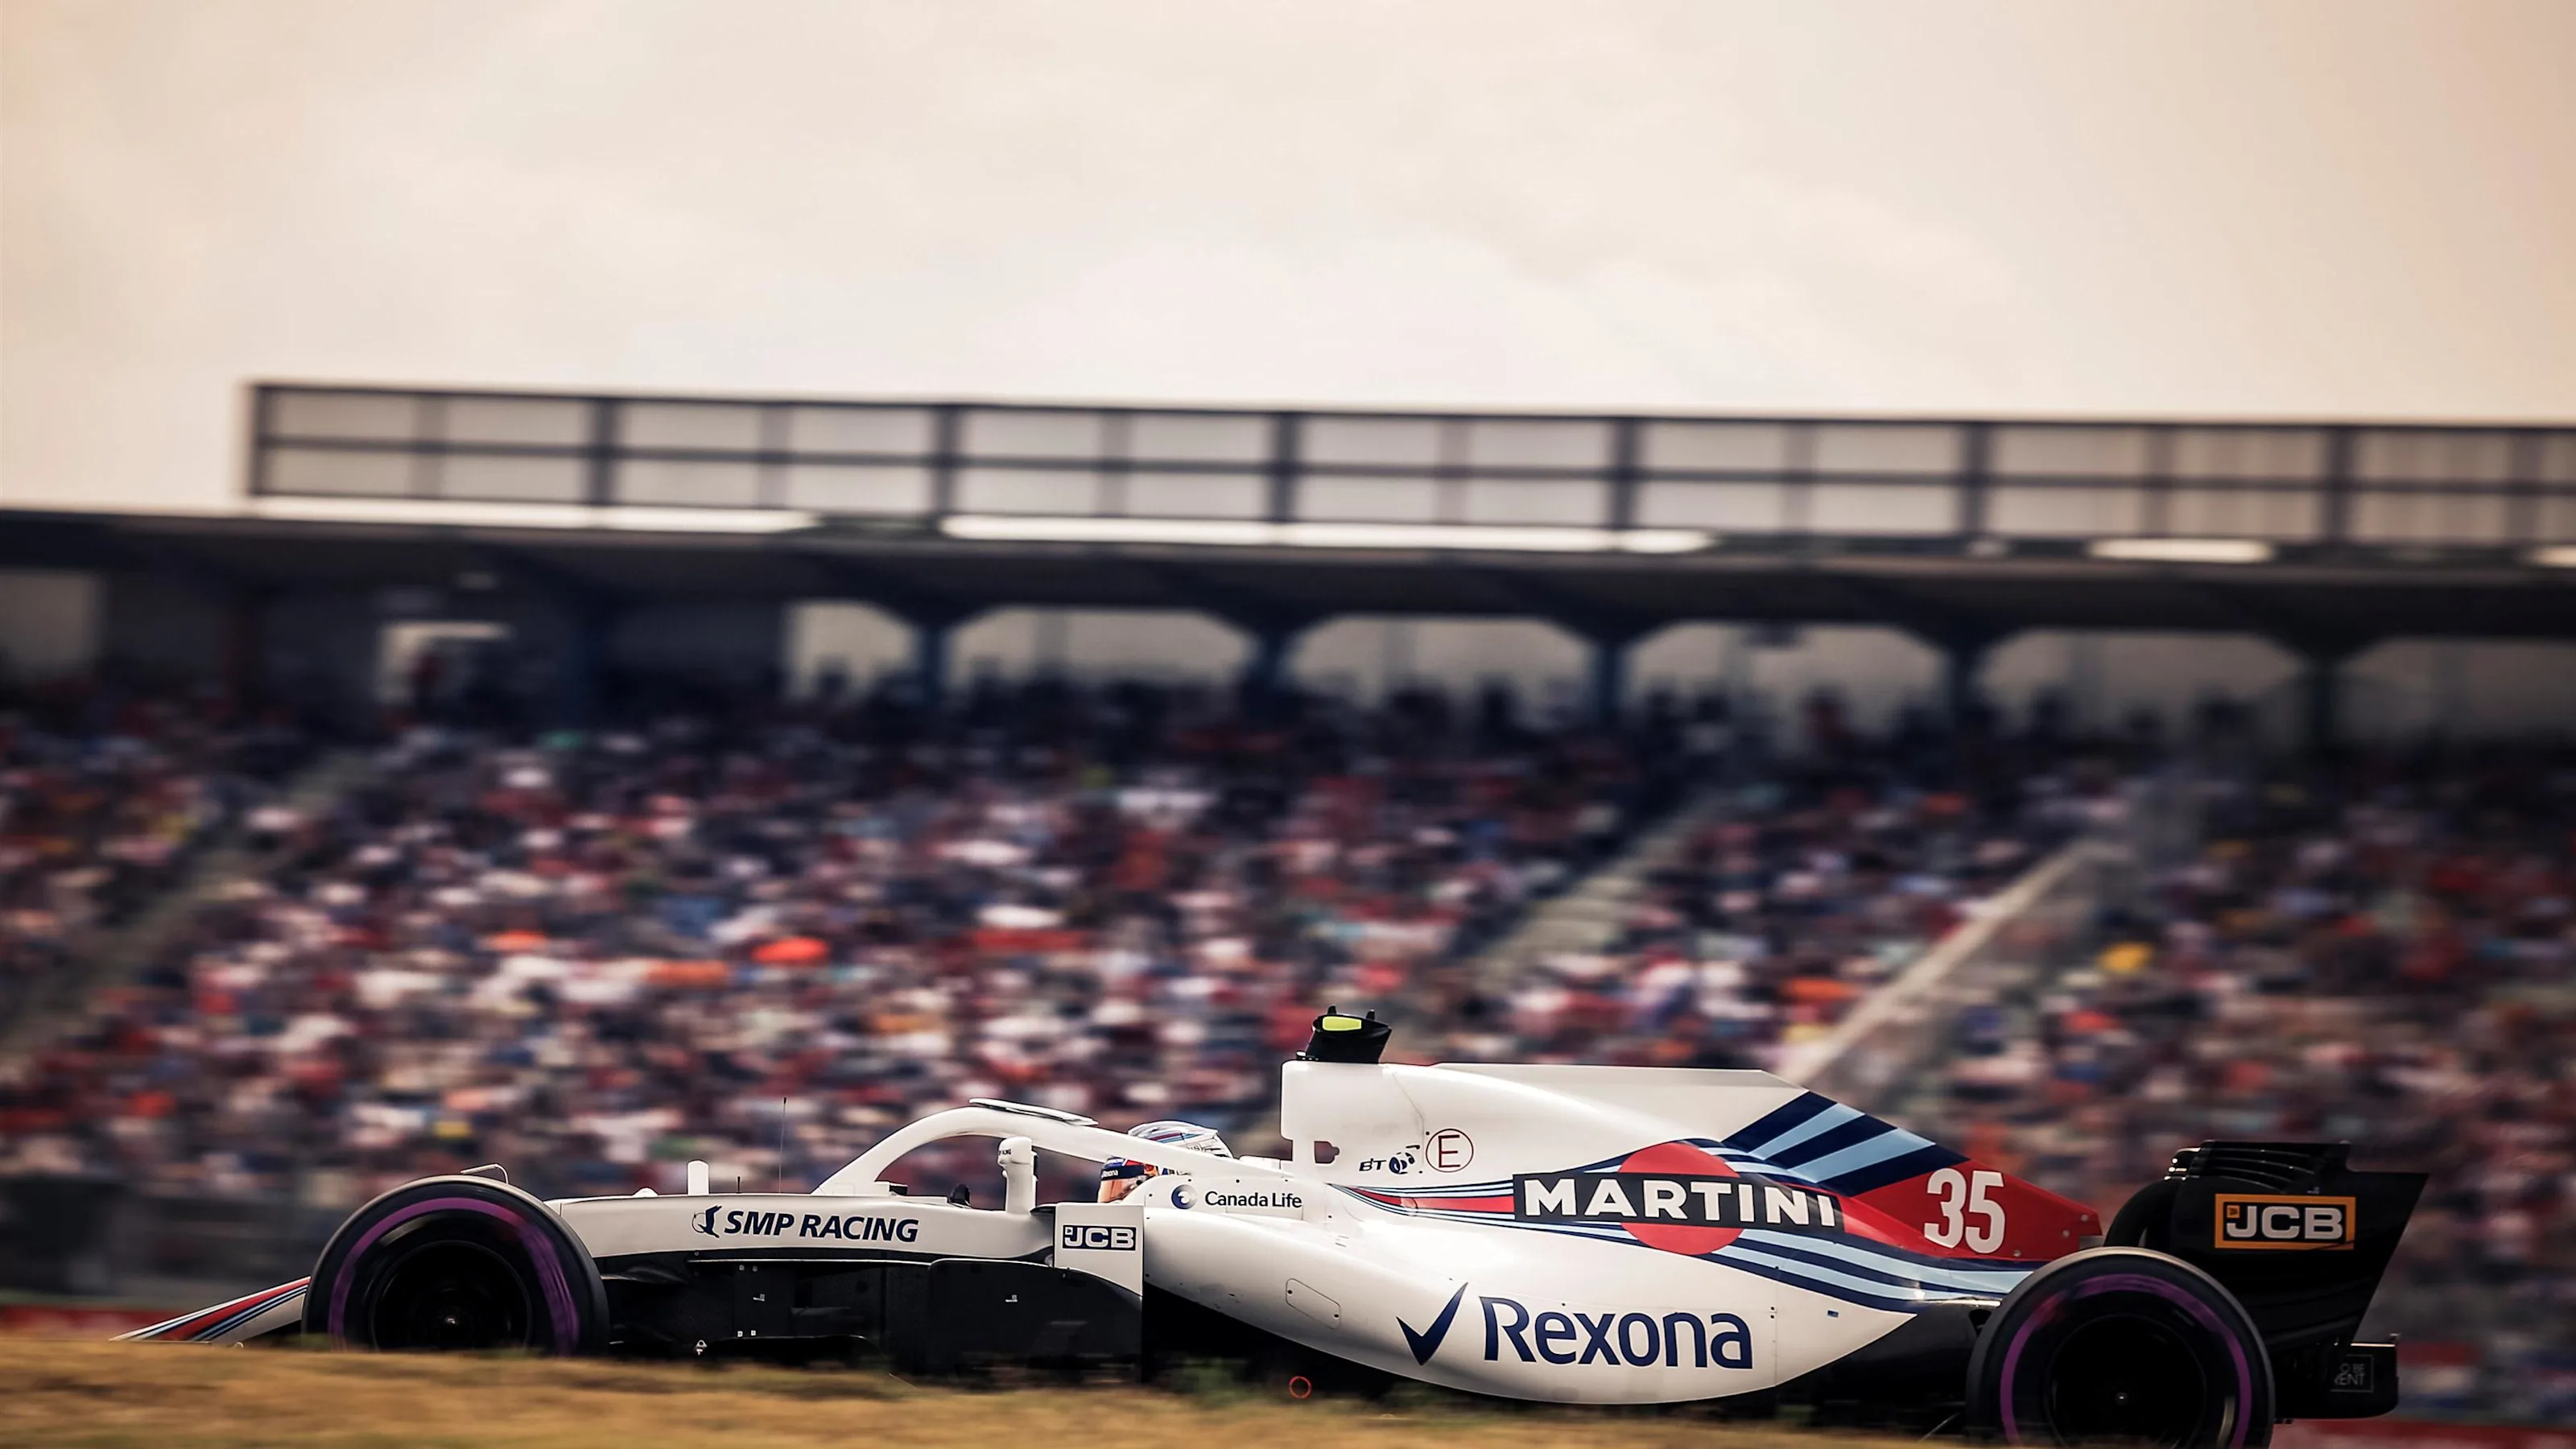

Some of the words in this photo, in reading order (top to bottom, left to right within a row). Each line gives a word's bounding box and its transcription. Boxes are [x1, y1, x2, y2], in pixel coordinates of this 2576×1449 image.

[1359, 1158, 1387, 1172] BT
[1438, 1134, 1462, 1169] E
[1204, 1191, 1268, 1208] Canada
[1272, 1191, 1302, 1210] Life
[1524, 1178, 1835, 1227] MARTINI
[1923, 1167, 2006, 1254] 35
[724, 1210, 795, 1236] SMP
[798, 1214, 919, 1243] RACING
[1064, 1226, 1134, 1249] JCB
[2226, 1205, 2343, 1240] JCB
[1480, 1295, 1753, 1369] Rexona
